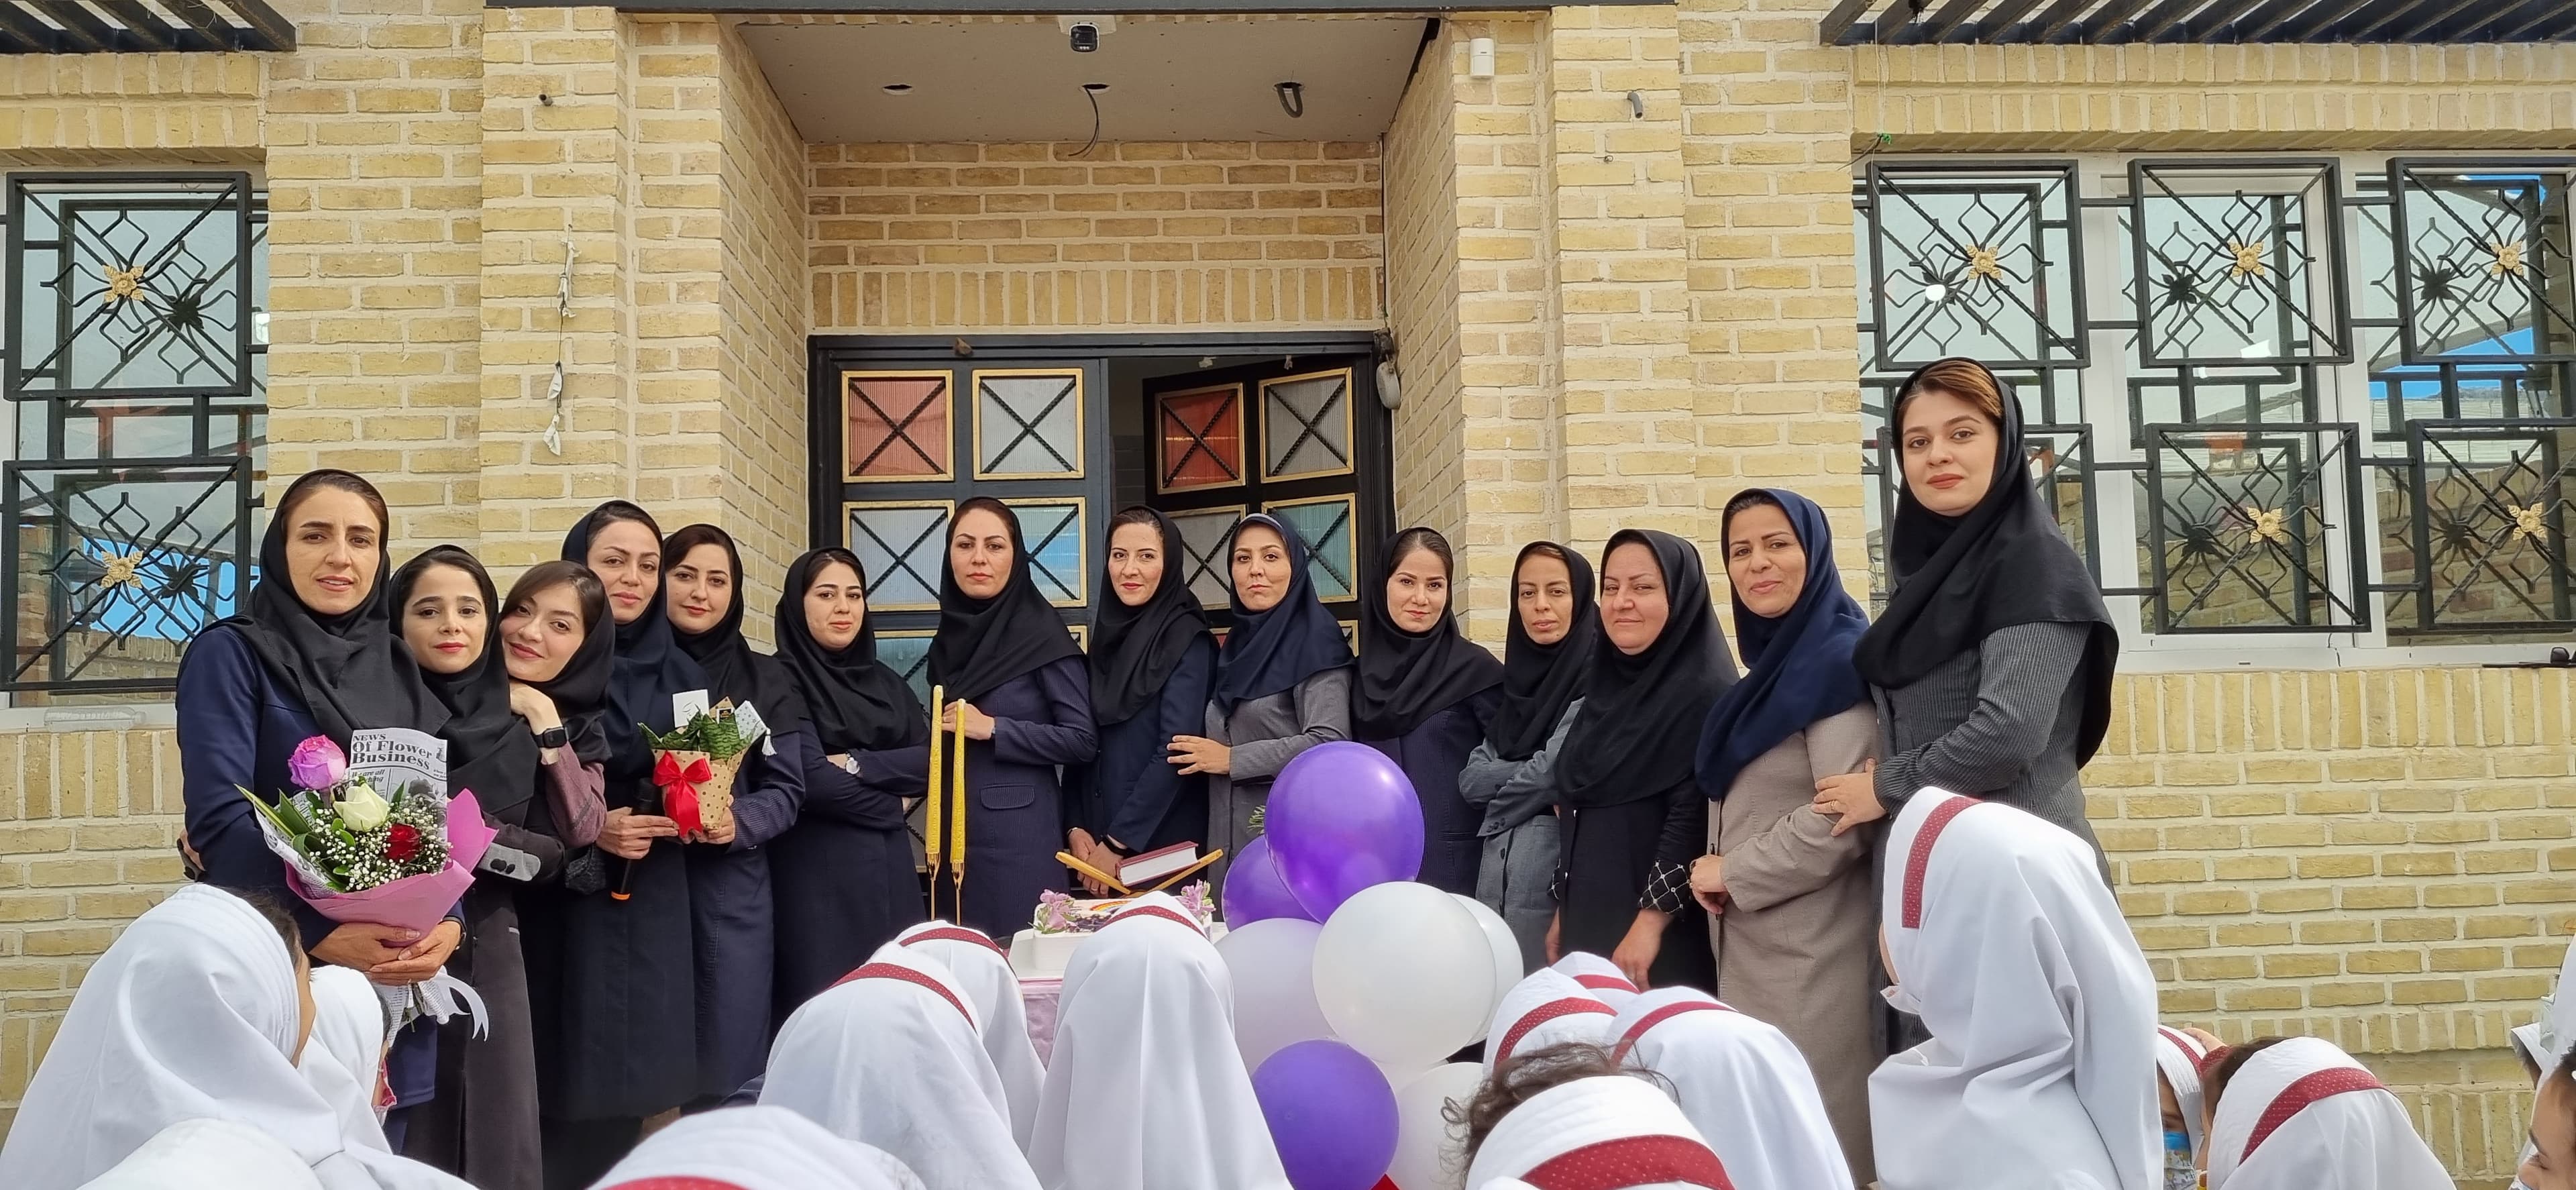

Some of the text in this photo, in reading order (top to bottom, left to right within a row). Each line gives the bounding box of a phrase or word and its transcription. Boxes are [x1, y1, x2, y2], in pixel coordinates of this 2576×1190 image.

[353, 733, 386, 741] NEWS
[352, 741, 433, 759] Of Flower
[352, 751, 430, 770] Business
